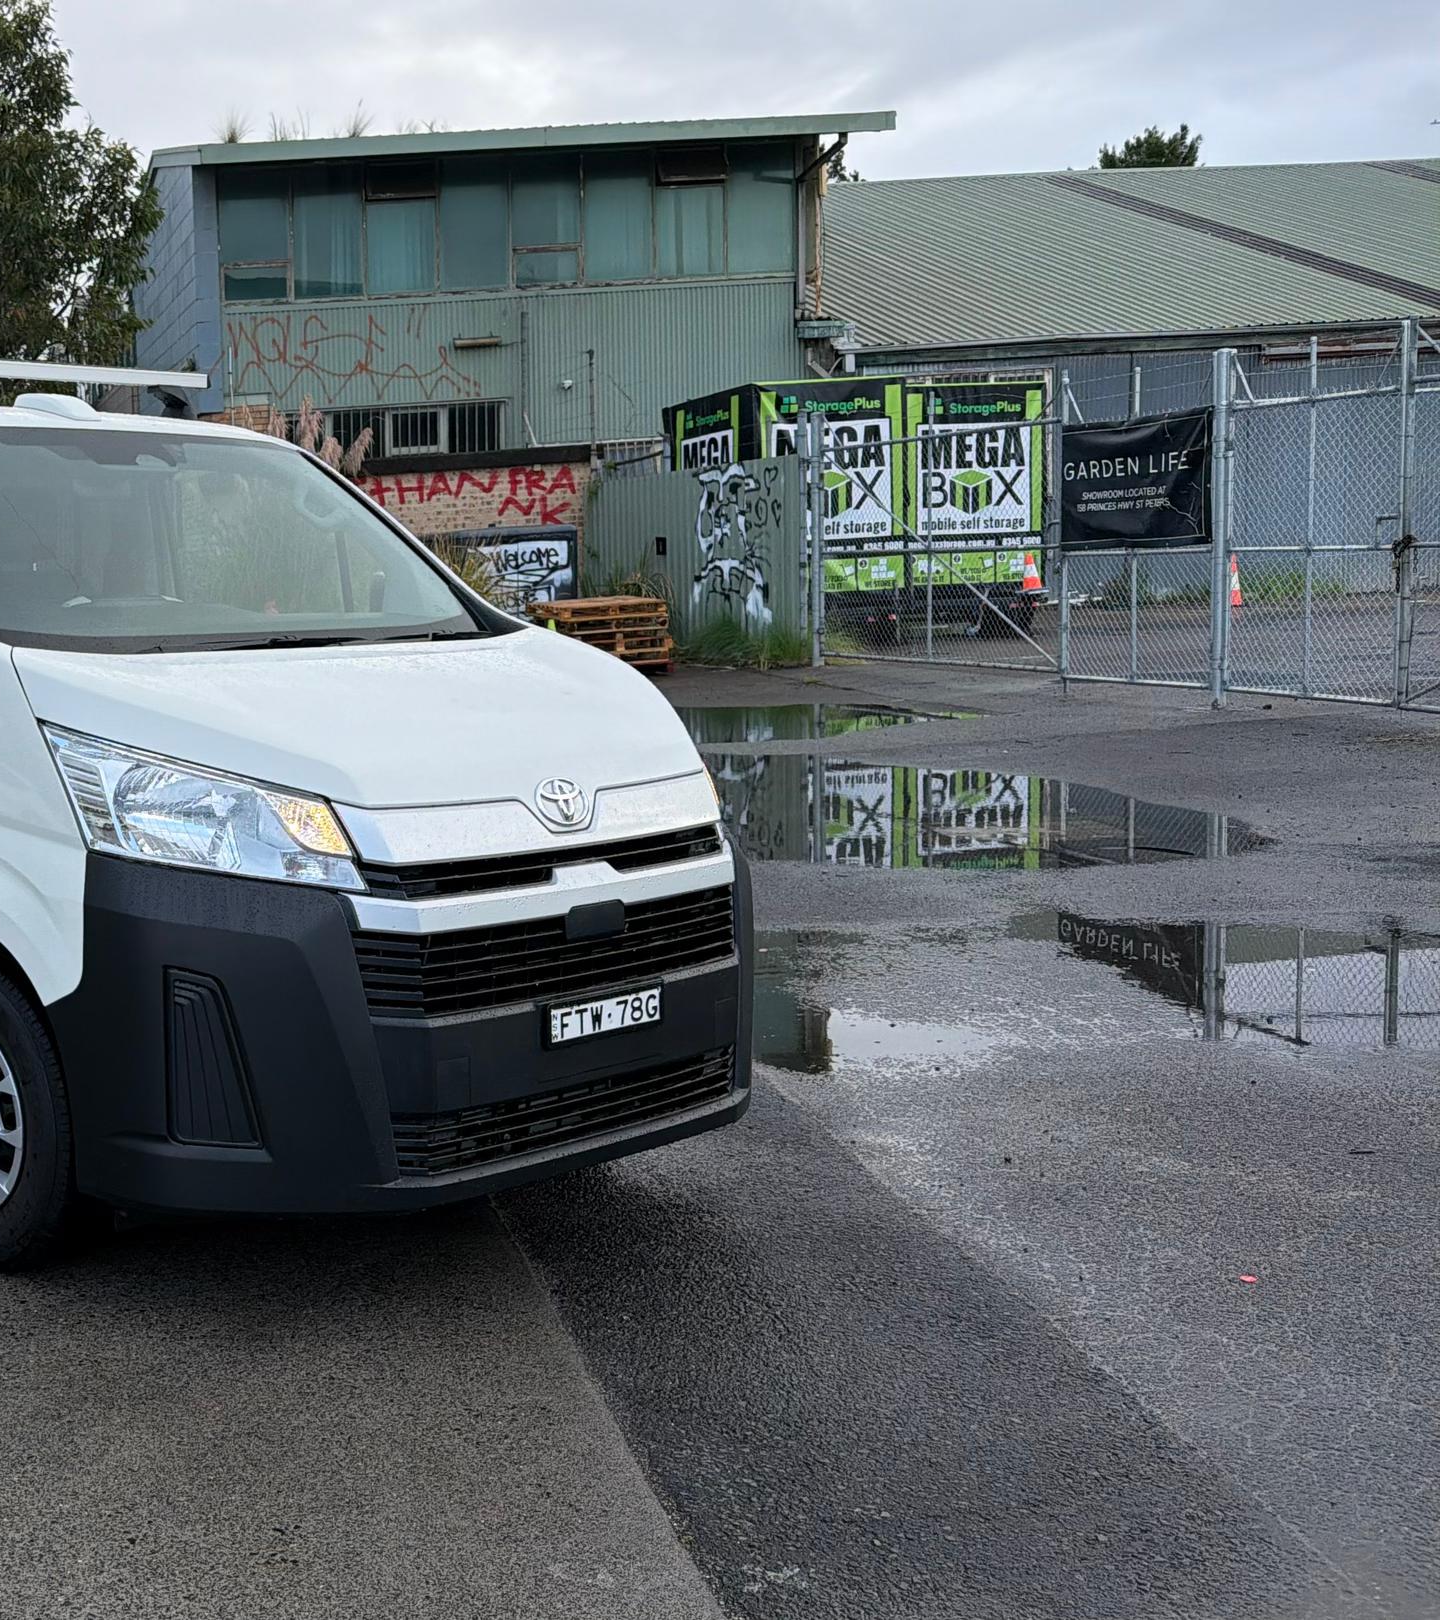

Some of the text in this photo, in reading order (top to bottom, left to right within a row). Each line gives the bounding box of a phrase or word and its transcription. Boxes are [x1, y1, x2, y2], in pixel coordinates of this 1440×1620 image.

[805, 397, 881, 415] StoragePlus
[950, 401, 1021, 416] StoragePlus
[921, 426, 1025, 469] MEGA
[1063, 450, 1189, 480] GARDEN LIFE
[352, 470, 499, 507] THAN
[1081, 485, 1167, 501] SHOWROOM LOCATED AT
[1087, 502, 1117, 512] PRINCES
[1118, 500, 1134, 510] HWY
[1135, 499, 1144, 509] ST
[824, 520, 887, 535] elf storage
[960, 516, 980, 530] self
[984, 516, 1025, 529] storage
